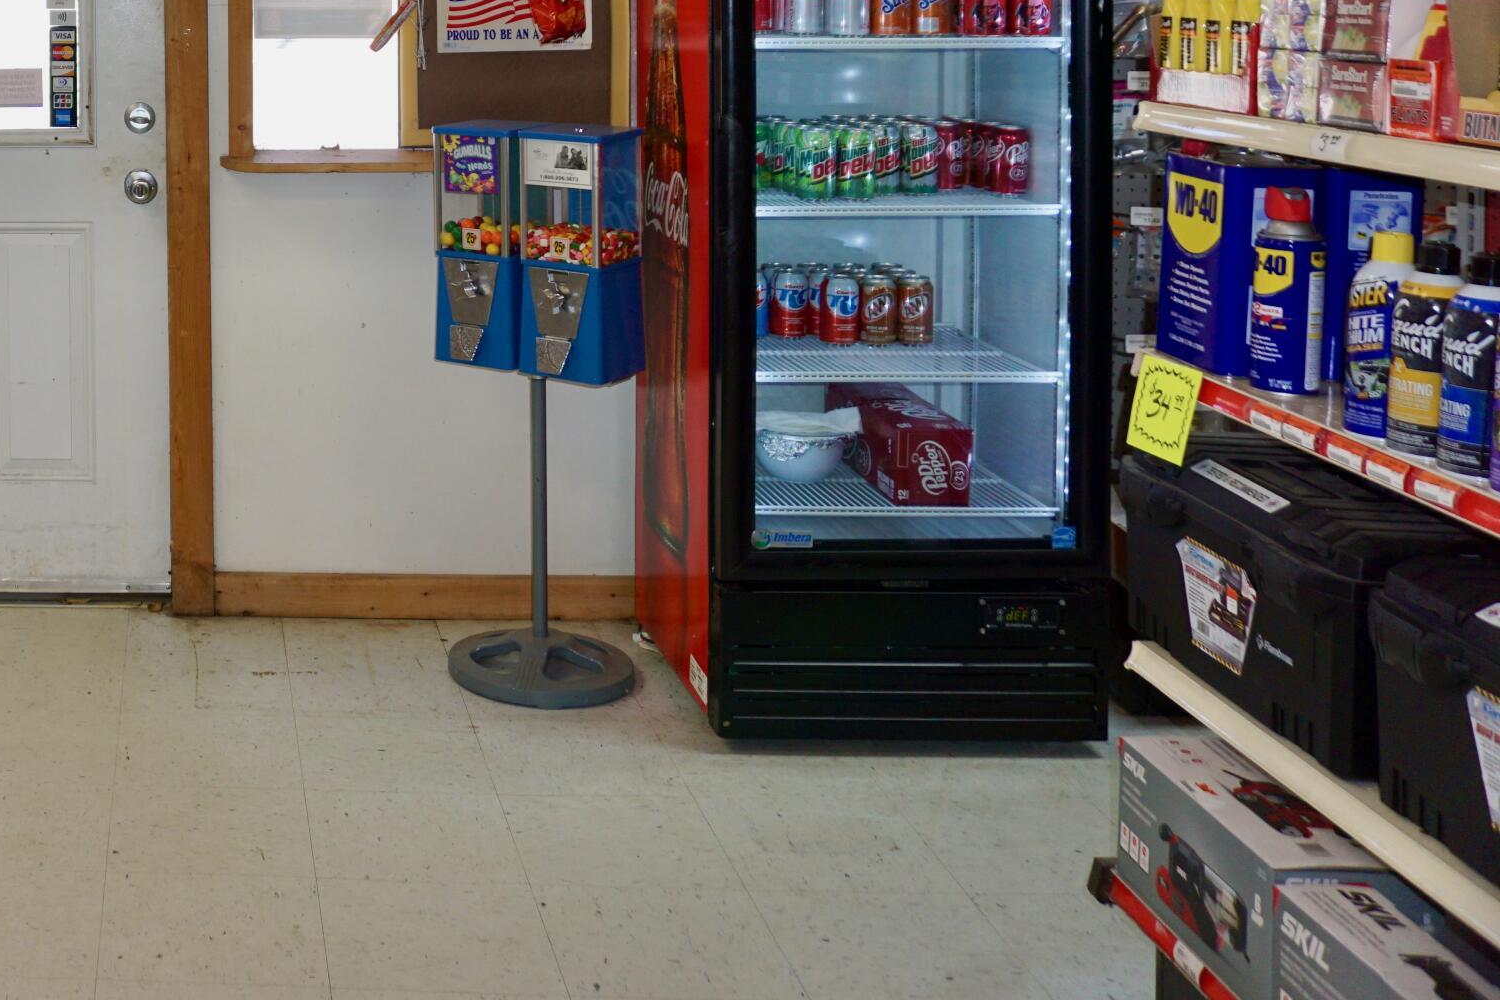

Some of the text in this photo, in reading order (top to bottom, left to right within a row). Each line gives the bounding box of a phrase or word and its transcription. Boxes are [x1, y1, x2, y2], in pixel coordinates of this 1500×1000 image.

[446, 29, 480, 41] PROUD
[484, 29, 496, 40] TO
[500, 29, 512, 40] BE
[516, 28, 529, 40] AN
[453, 144, 492, 160] GUMBALLS
[644, 161, 689, 248] Coca-Cola
[1174, 180, 1219, 225] WD-40
[921, 444, 949, 496] Pepper
[772, 532, 812, 544] Imbera
[1122, 751, 1147, 785] SKIL
[1280, 911, 1330, 972] SKIL
